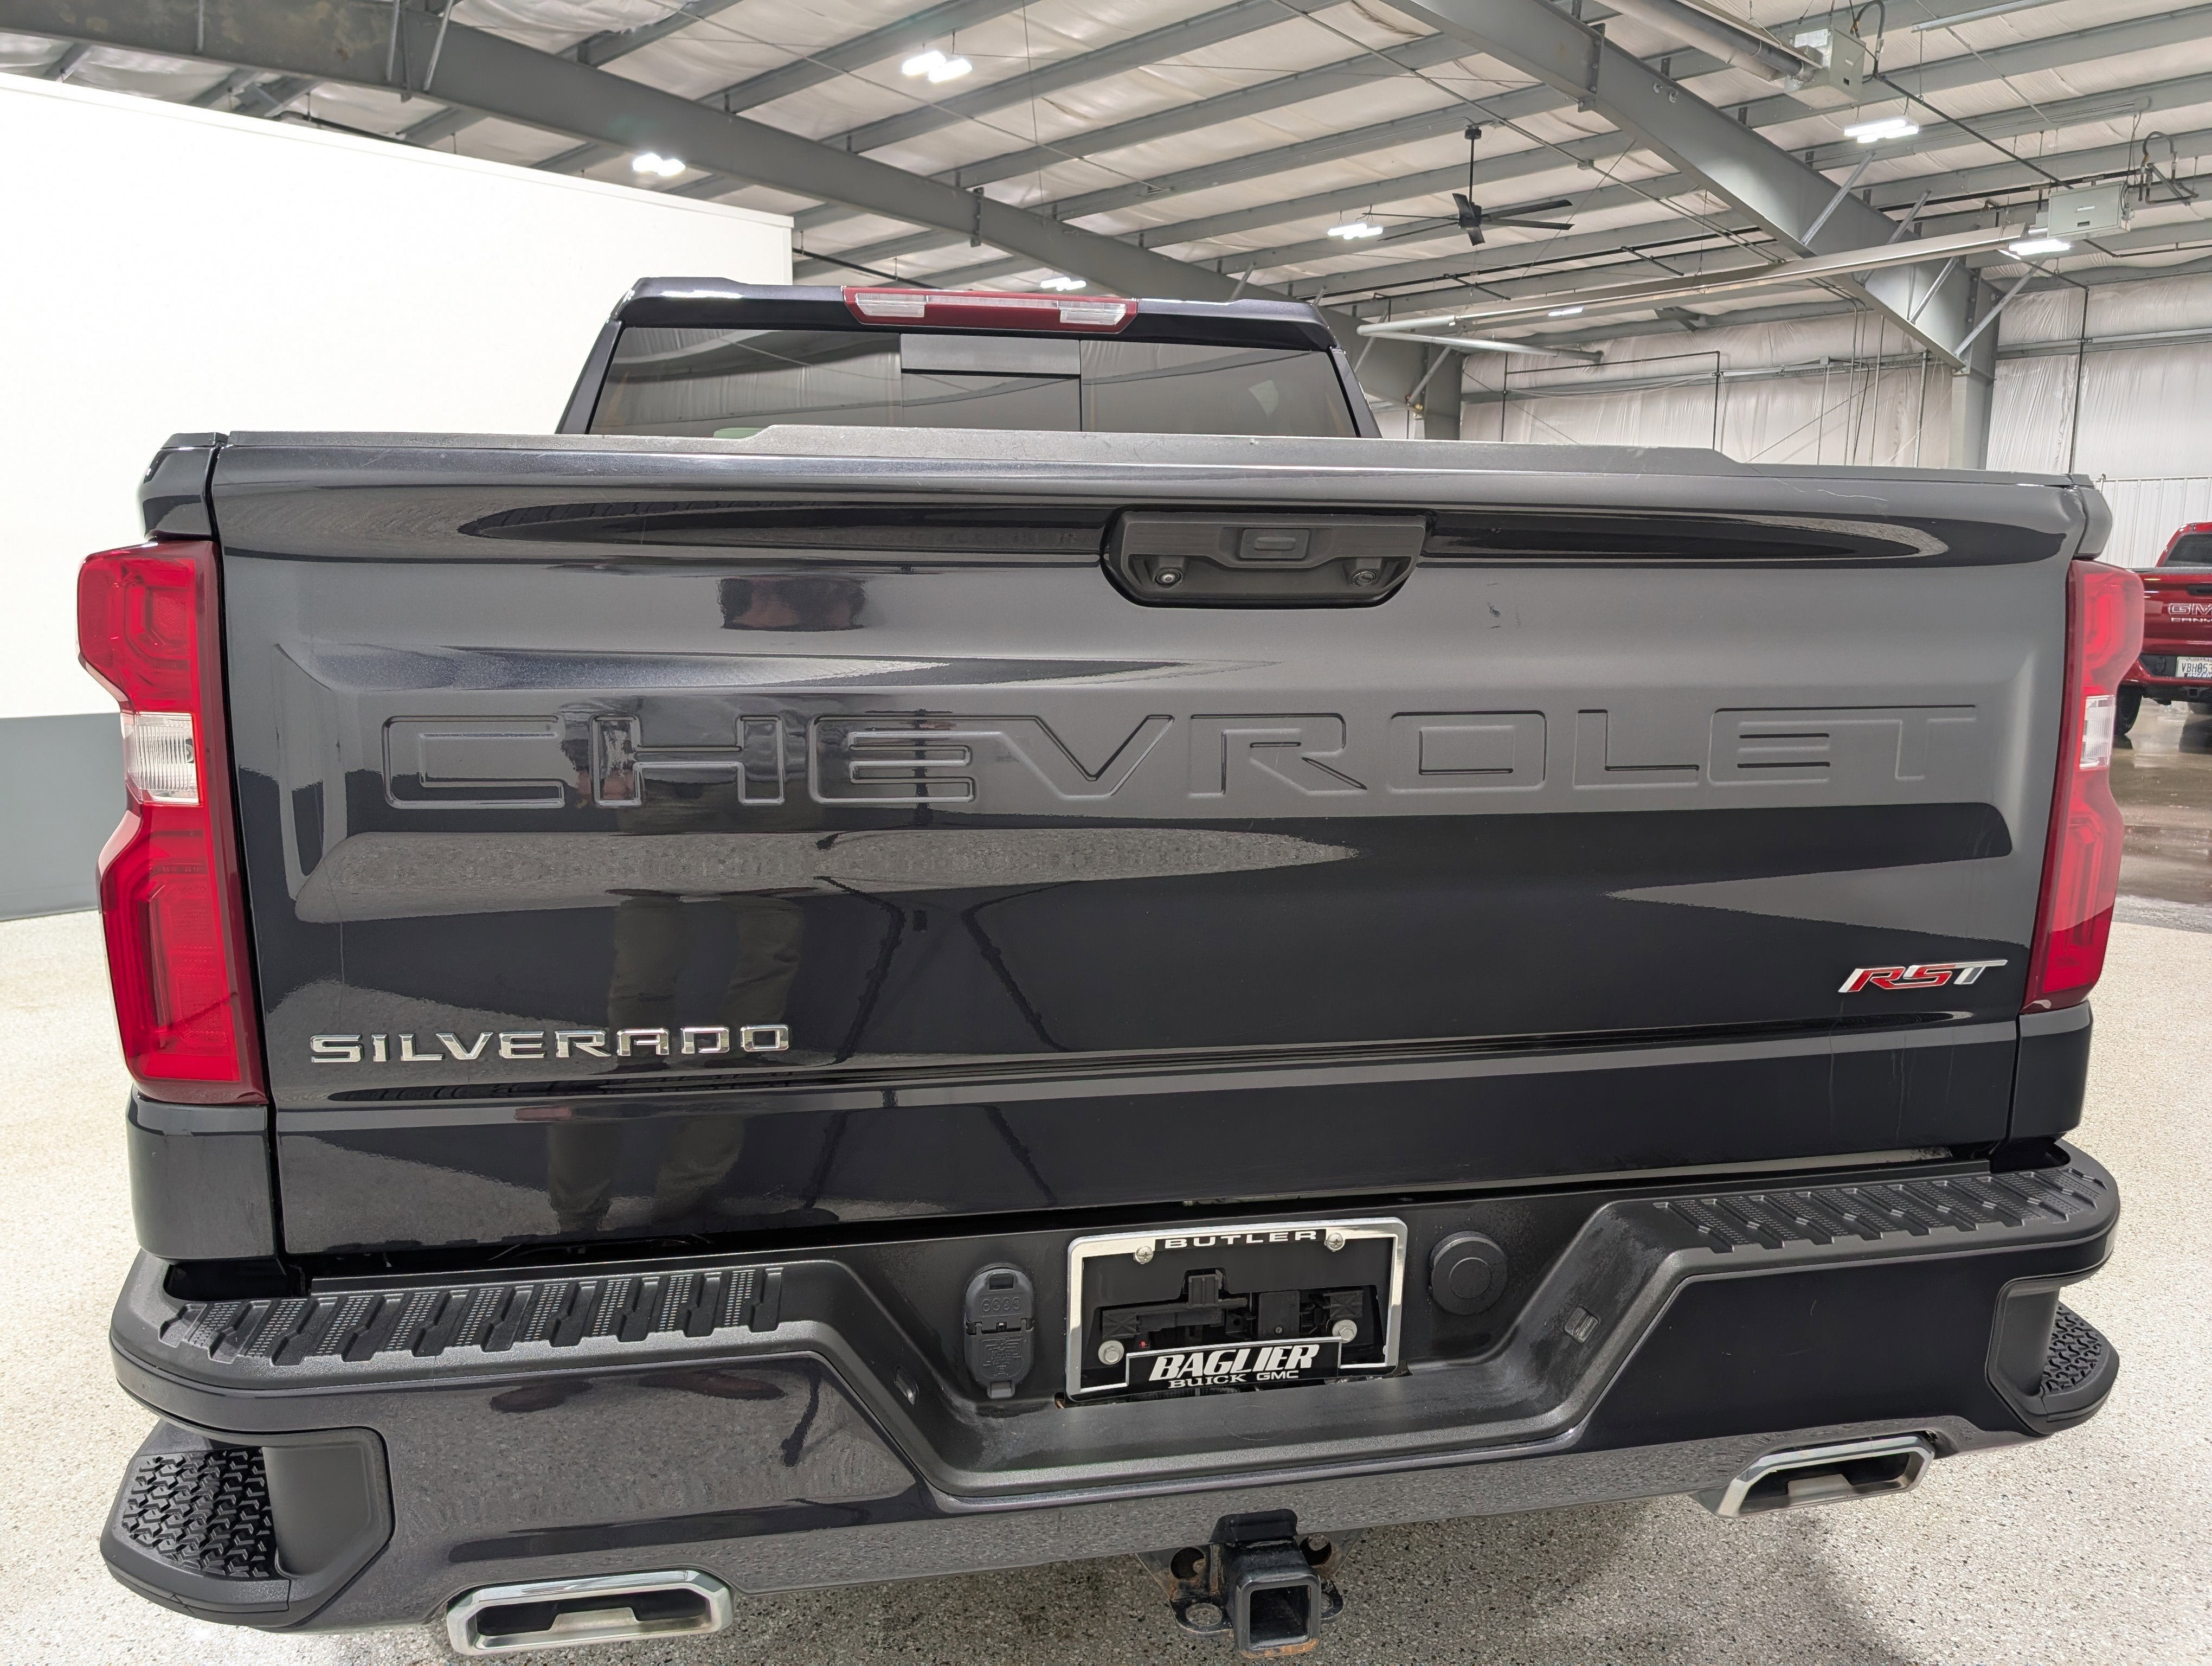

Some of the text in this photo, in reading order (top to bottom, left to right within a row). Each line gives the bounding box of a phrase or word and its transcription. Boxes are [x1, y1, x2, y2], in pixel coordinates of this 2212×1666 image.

[382, 706, 1976, 809] CHEVROLET
[1838, 959, 2008, 993] RST
[310, 1024, 792, 1063] SILVERADO
[1164, 1229, 1318, 1249] BUTLER
[1149, 1344, 1320, 1382] BAGLIER
[1168, 1369, 1299, 1389] BUICK GMC
